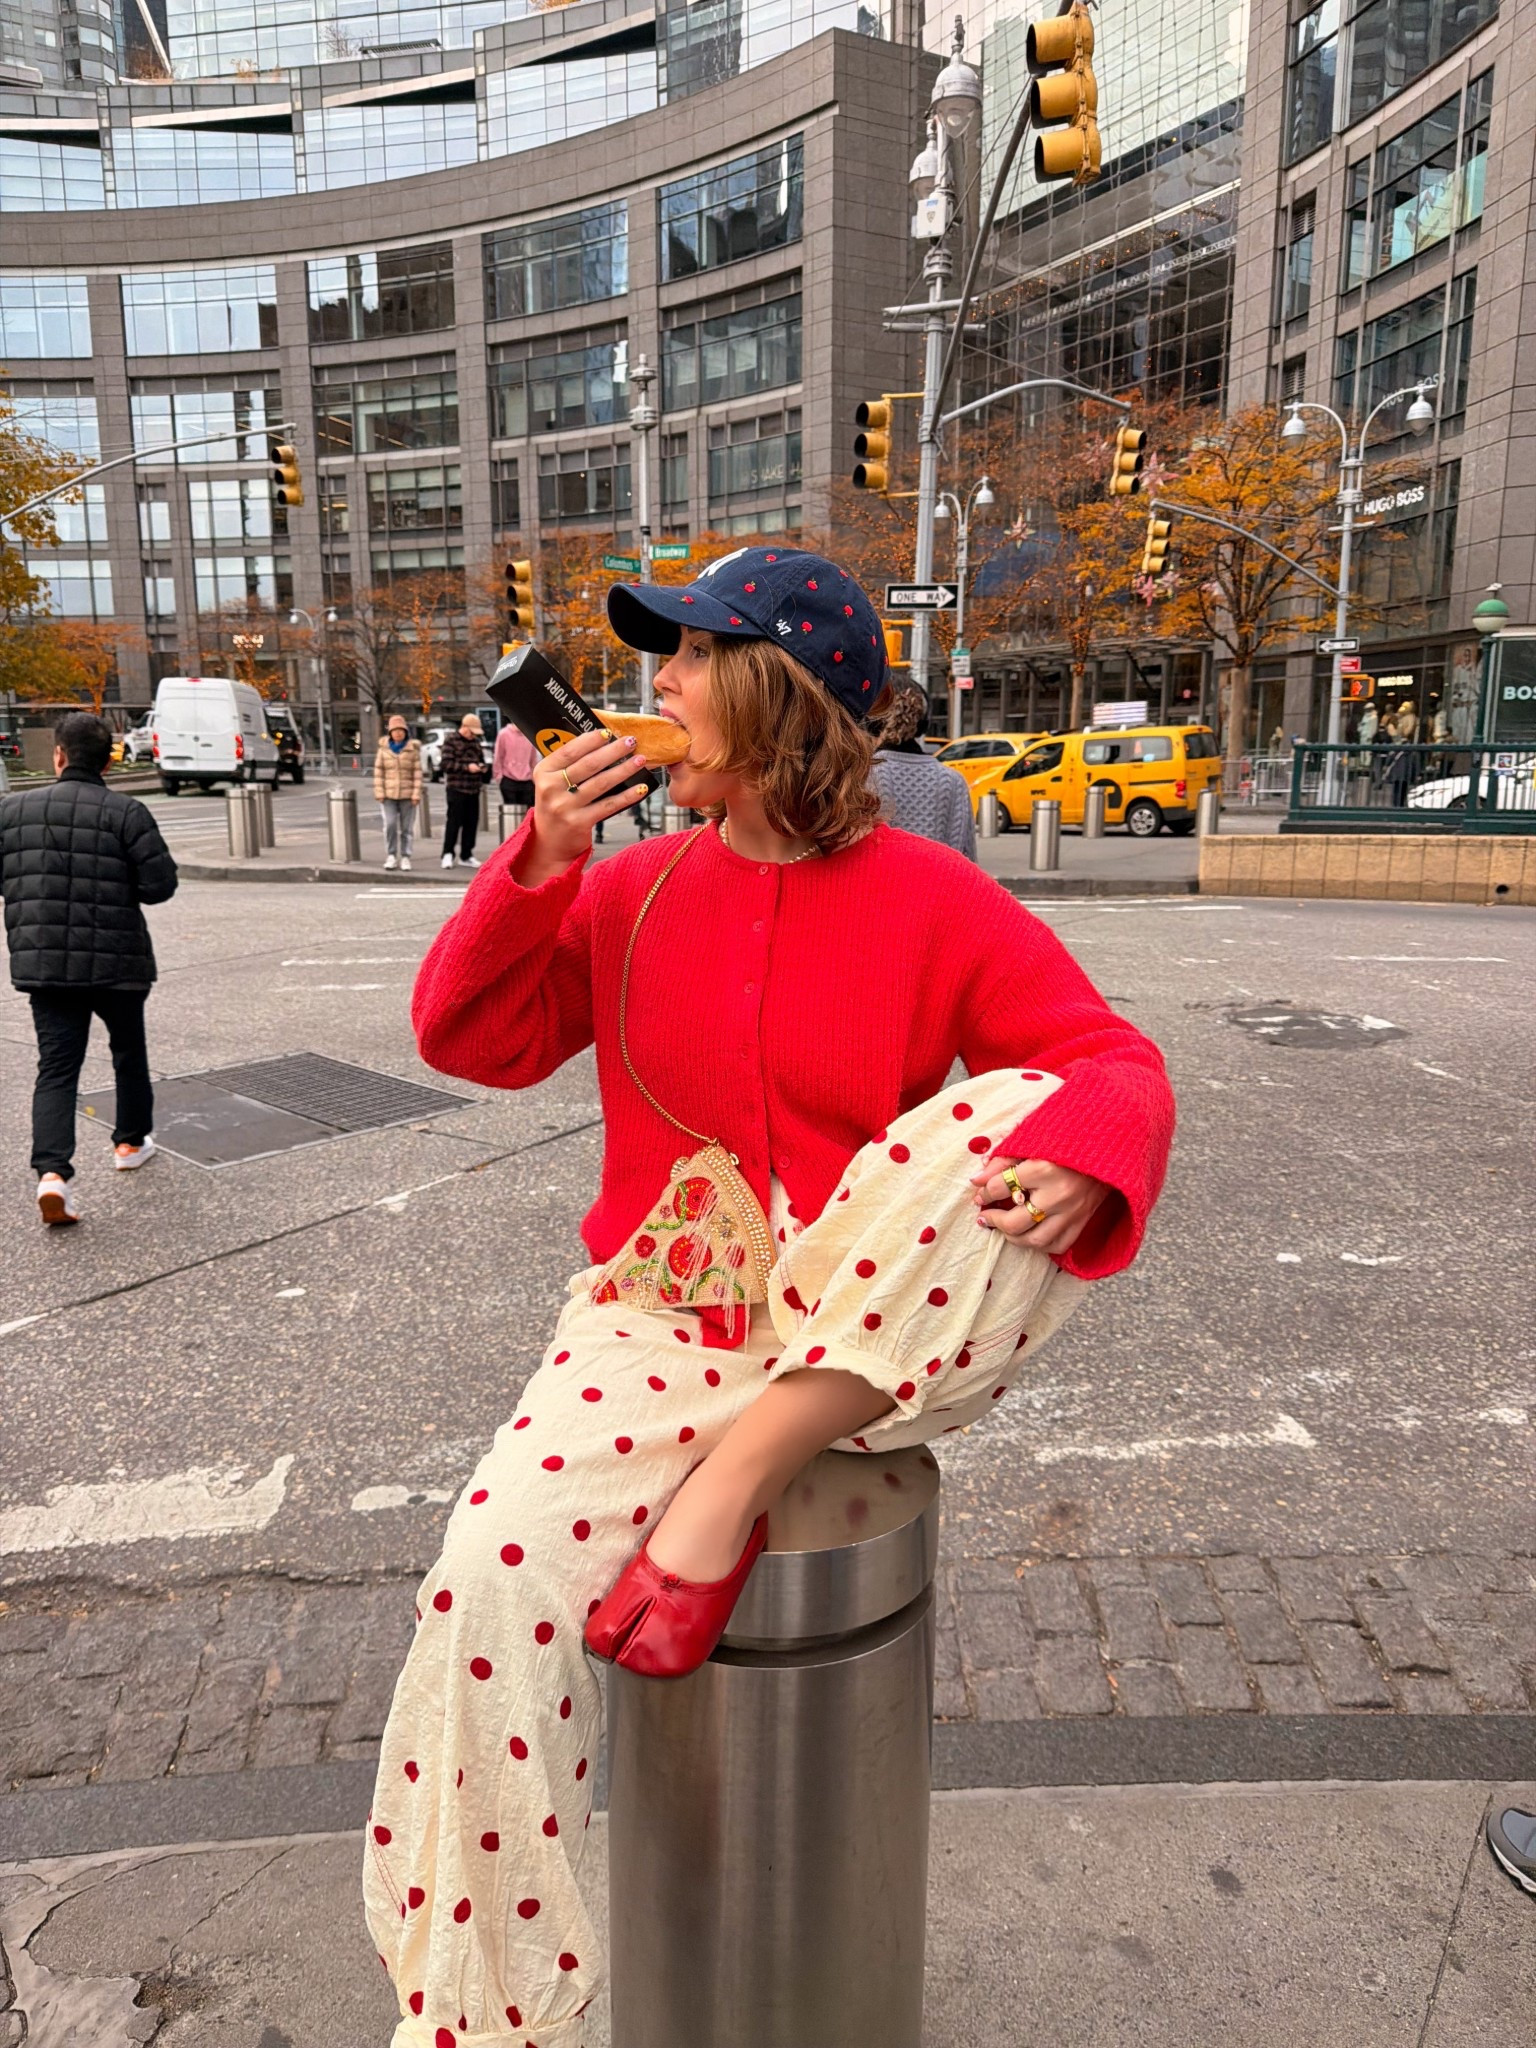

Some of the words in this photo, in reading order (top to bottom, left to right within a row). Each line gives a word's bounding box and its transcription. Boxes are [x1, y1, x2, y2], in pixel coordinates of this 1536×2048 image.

[1363, 495, 1395, 515] HUGO
[1396, 486, 1425, 507] BOSS
[655, 547, 687, 558] Broadway
[605, 556, 633, 571] Columbus
[896, 592, 917, 602] ONE
[926, 592, 948, 602] WAY
[544, 677, 571, 705] YORK
[564, 700, 585, 723] NEW
[579, 721, 594, 734] OF
